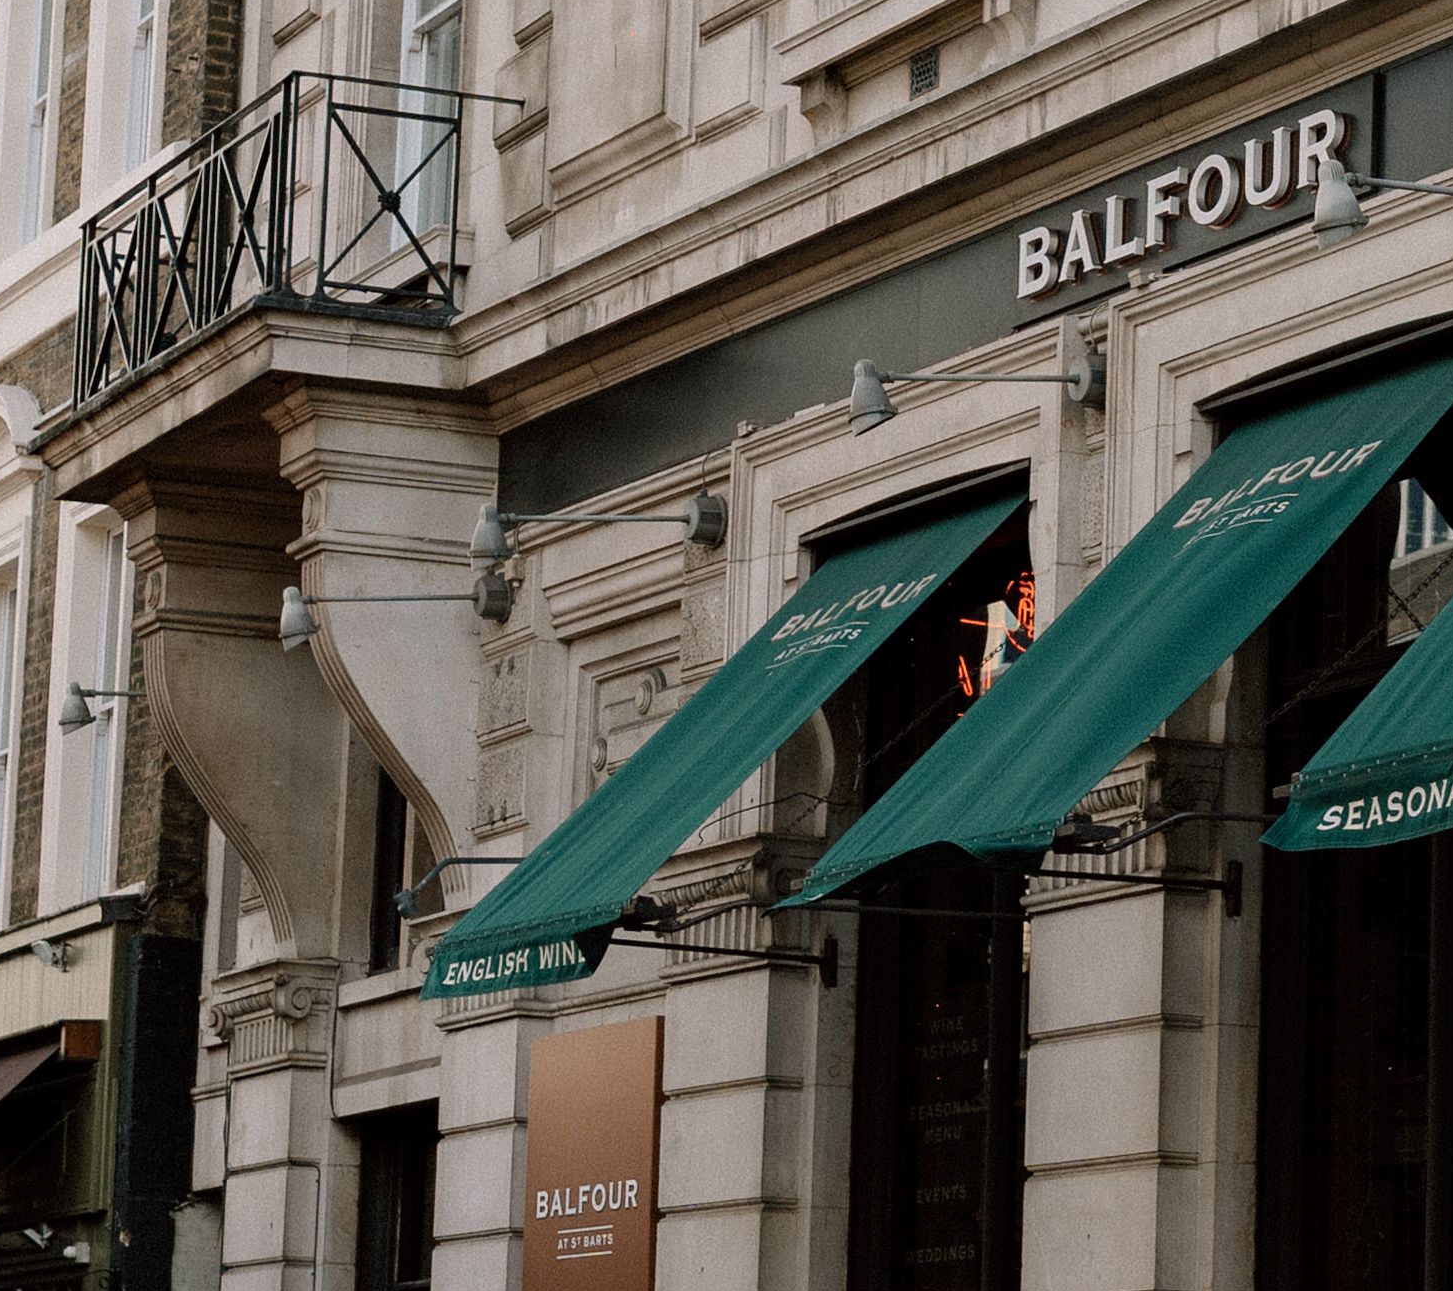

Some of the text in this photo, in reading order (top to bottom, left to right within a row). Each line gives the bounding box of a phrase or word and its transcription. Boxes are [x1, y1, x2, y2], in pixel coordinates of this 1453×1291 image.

[1016, 109, 1349, 302] BALFOUR
[1173, 440, 1382, 529] BALFOUR
[771, 573, 937, 642] BALFOUR
[442, 948, 531, 985] ENGLISH
[536, 1179, 638, 1219] BALFOUR
[557, 1238, 568, 1250] AT
[584, 1233, 613, 1247] BARTS
